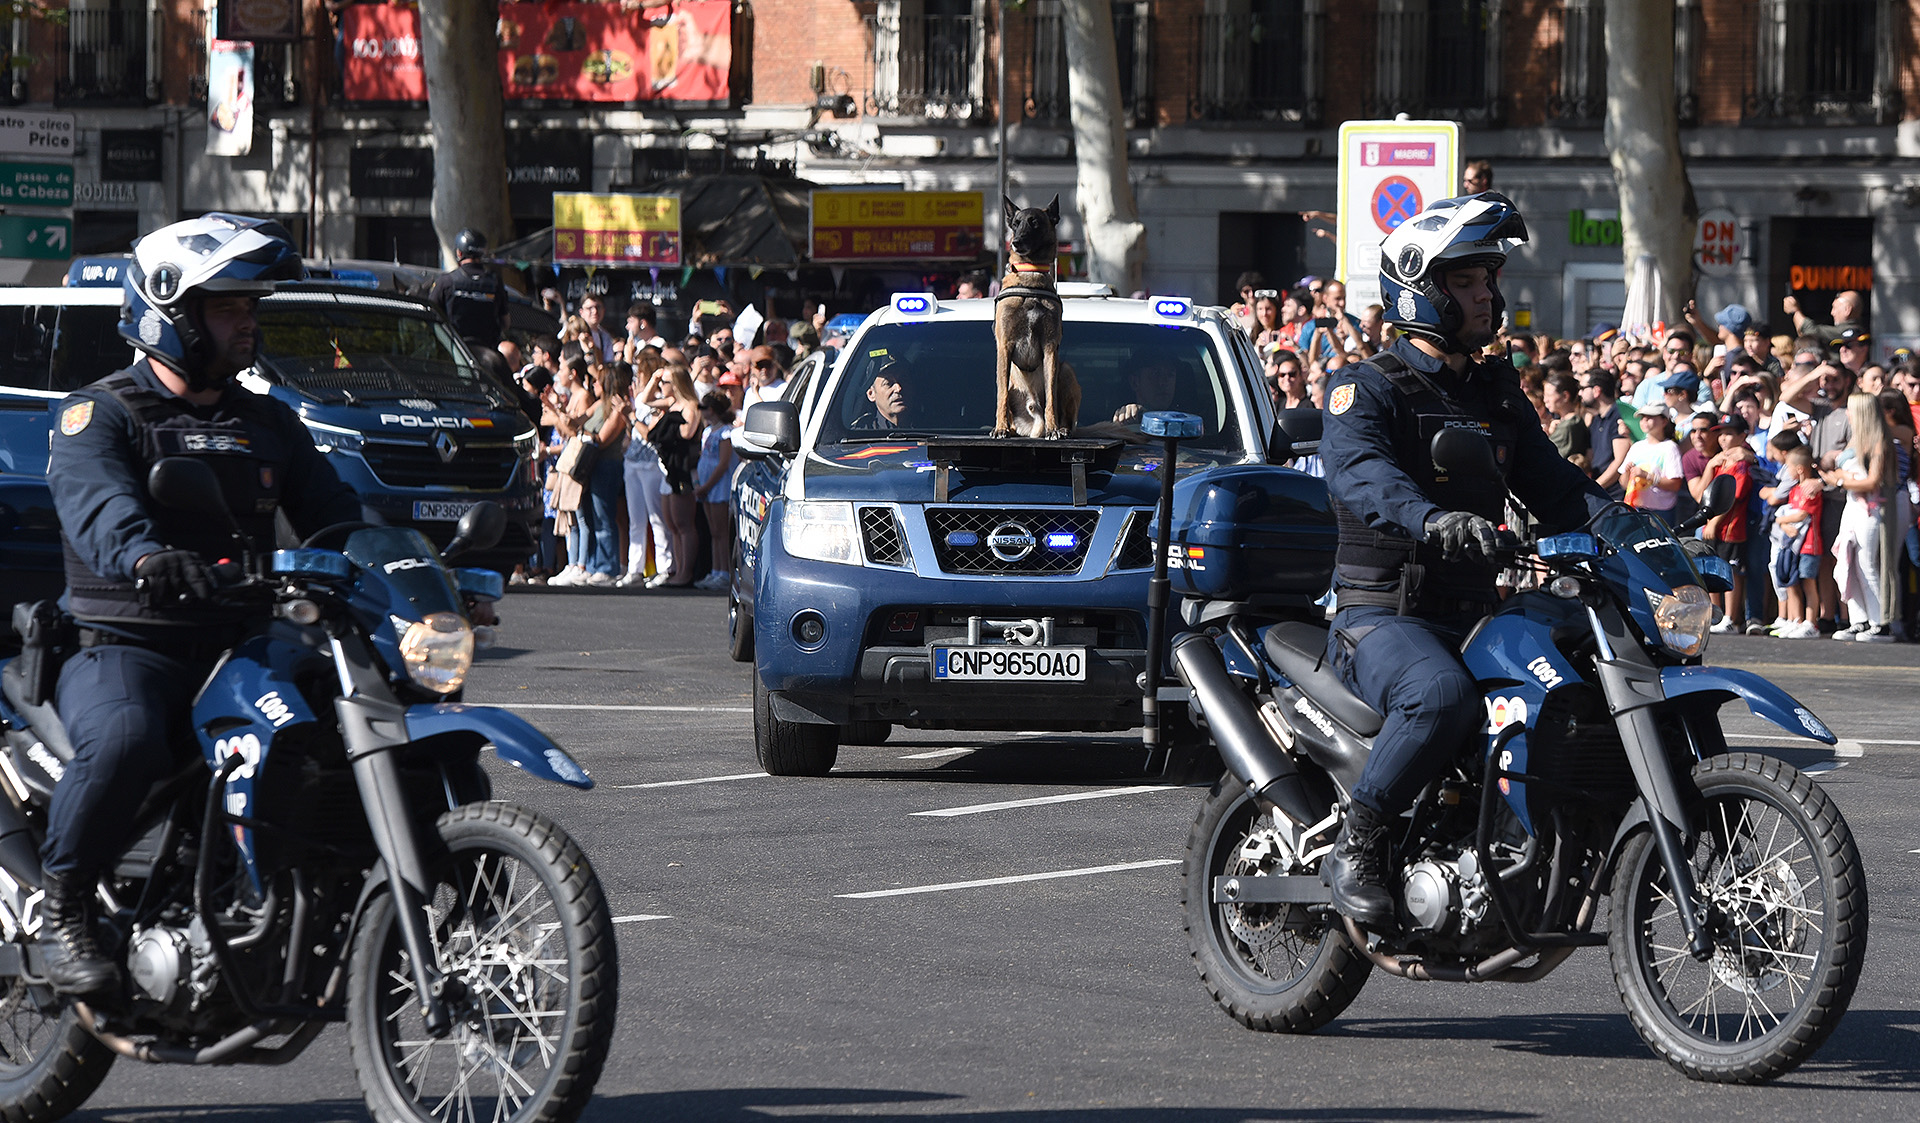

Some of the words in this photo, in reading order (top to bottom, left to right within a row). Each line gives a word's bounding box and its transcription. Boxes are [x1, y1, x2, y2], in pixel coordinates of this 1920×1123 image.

[39, 118, 70, 131] circo
[29, 133, 69, 147] Price
[1394, 149, 1428, 160] MADRID
[15, 172, 49, 183] paseo
[56, 173, 70, 183] de
[18, 184, 69, 199] Cabeza
[74, 182, 136, 201] RODILLA
[1702, 221, 1734, 241] DN
[910, 242, 935, 252] HERE
[380, 414, 475, 428] POLICIA
[992, 537, 1031, 545] NISSAN
